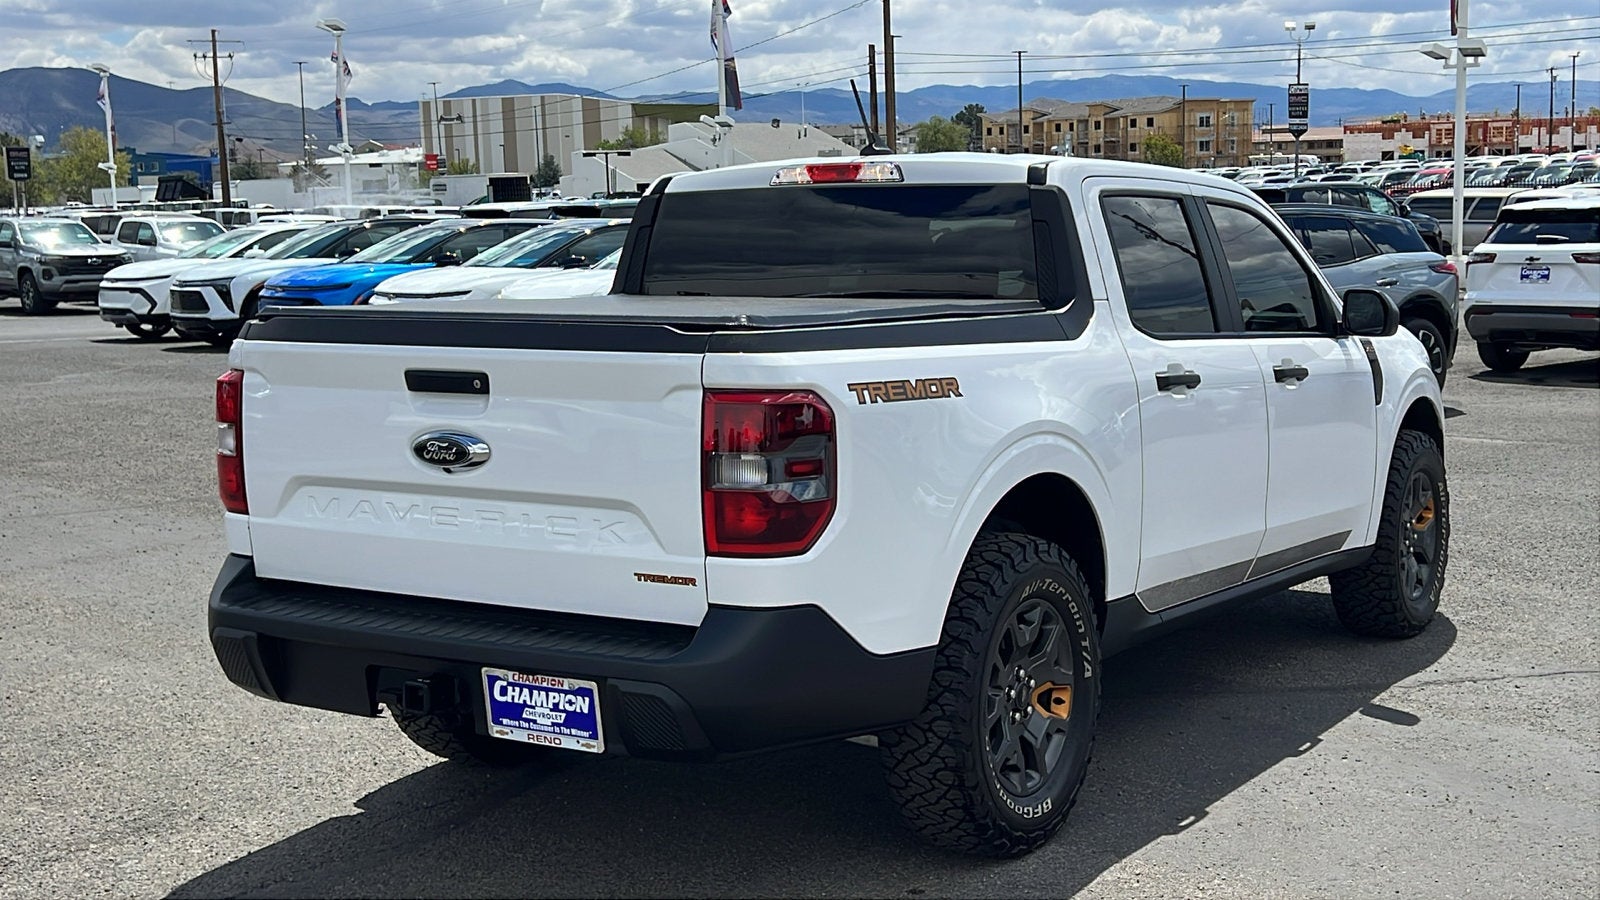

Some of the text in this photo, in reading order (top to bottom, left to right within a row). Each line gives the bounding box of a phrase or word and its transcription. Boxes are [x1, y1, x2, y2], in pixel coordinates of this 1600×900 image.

[847, 377, 964, 405] TREMOR
[424, 441, 458, 462] Ford
[305, 494, 628, 545] MAVERICK
[634, 572, 698, 587] TREMOR
[1080, 636, 1093, 679] T/A
[512, 672, 565, 688] CHAMPION
[493, 680, 590, 714] CHAMPION
[524, 708, 563, 722] CHEVROLET
[519, 720, 529, 730] The
[530, 721, 554, 733] Customer
[554, 725, 560, 733] Is
[560, 725, 571, 735] The
[526, 733, 562, 746] RENO
